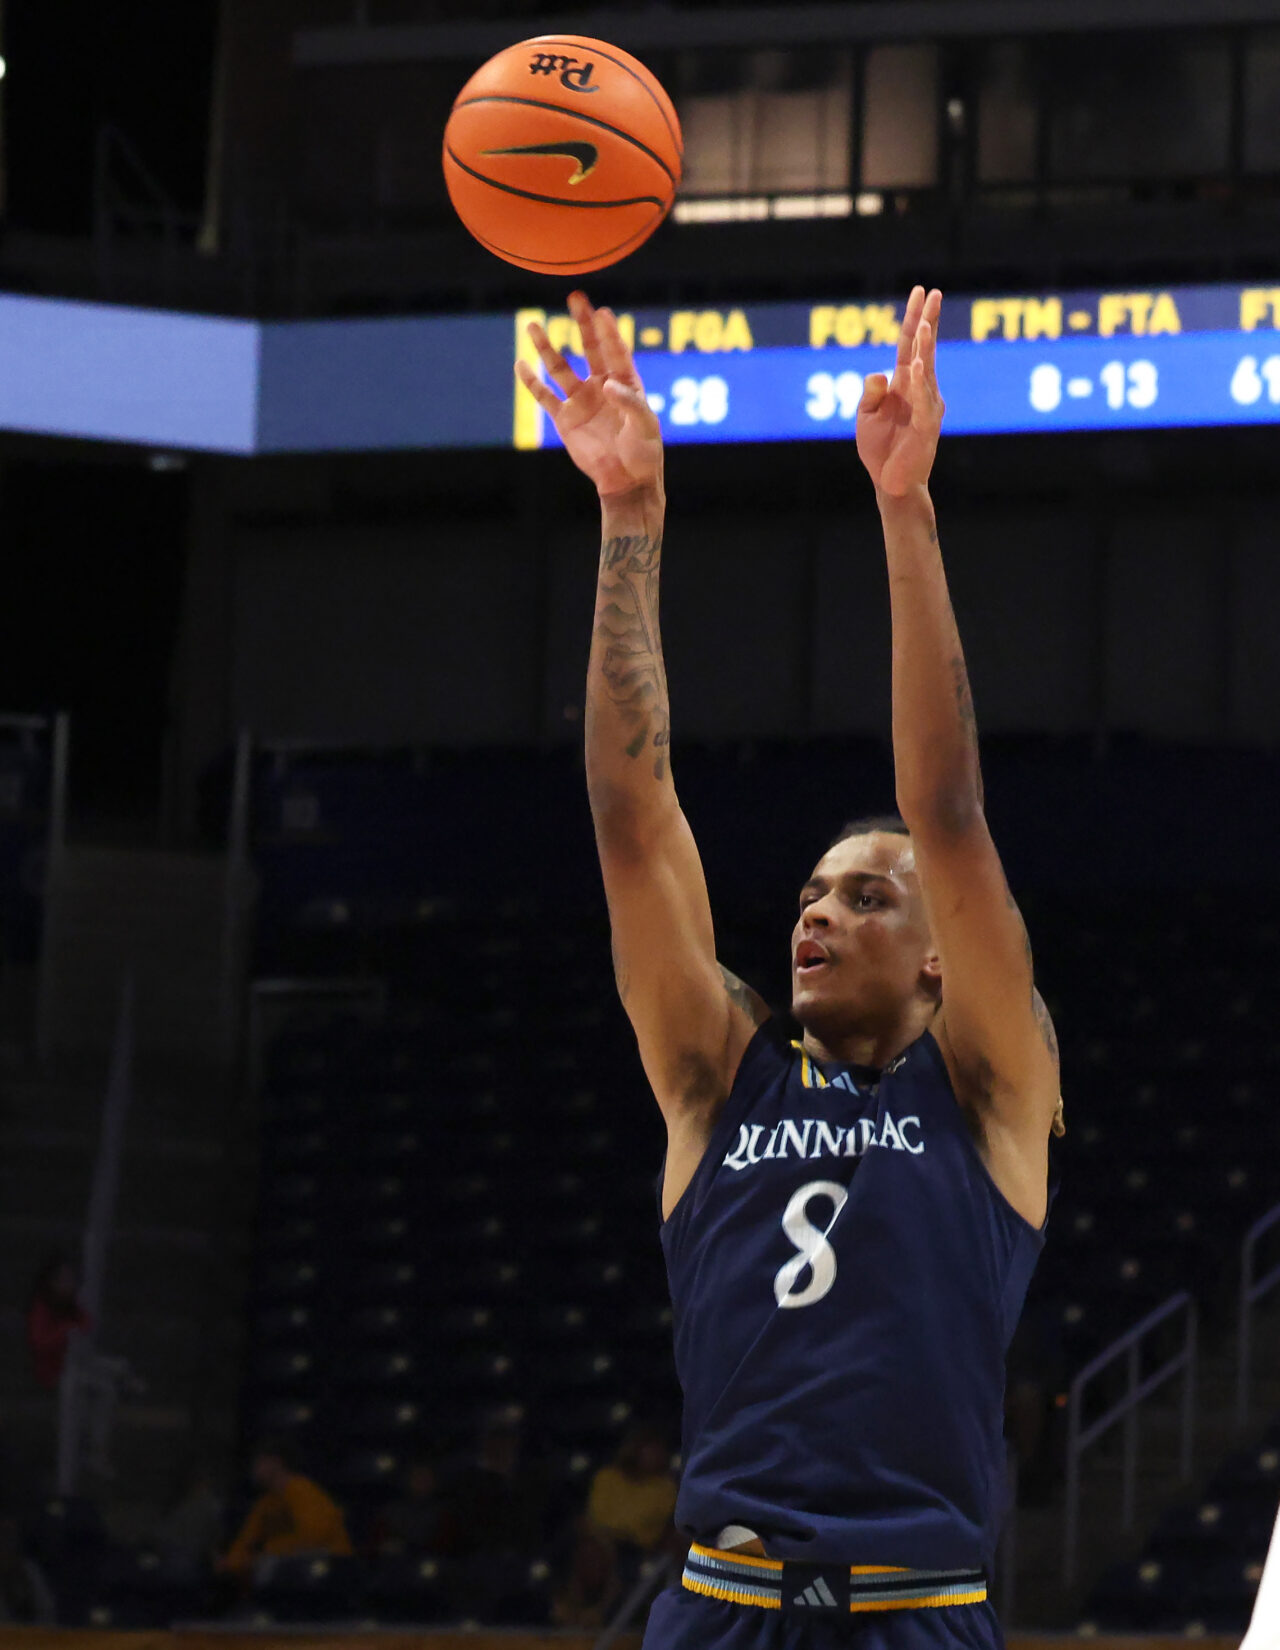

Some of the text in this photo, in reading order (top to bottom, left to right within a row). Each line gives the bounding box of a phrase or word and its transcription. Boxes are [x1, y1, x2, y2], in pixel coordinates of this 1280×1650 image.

[528, 53, 600, 93] Pitt
[970, 298, 1063, 343] FTM
[1098, 292, 1181, 337] FTA
[670, 376, 730, 426] 28
[1030, 362, 1063, 413] 8
[1100, 359, 1159, 410] 13
[773, 1180, 849, 1309] 8
